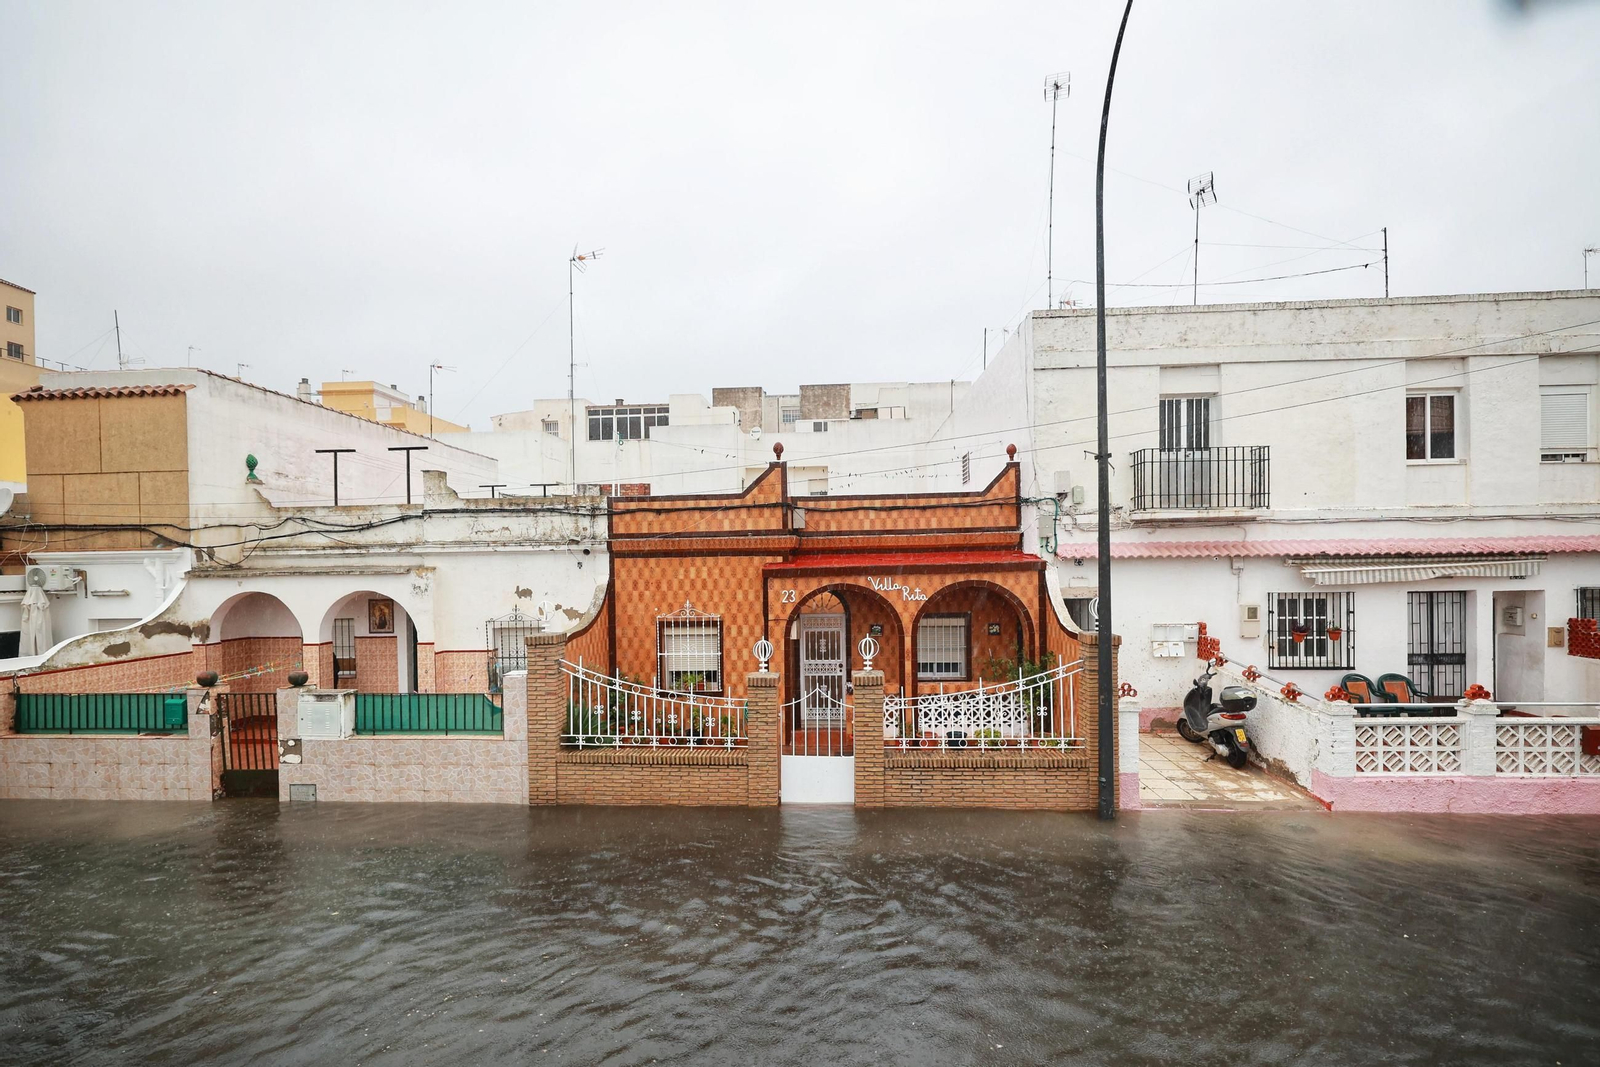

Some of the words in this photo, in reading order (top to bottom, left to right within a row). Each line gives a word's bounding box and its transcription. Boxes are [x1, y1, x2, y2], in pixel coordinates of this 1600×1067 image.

[781, 589, 796, 603] 23
[867, 576, 901, 591] Villa
[902, 586, 928, 601] Rita
